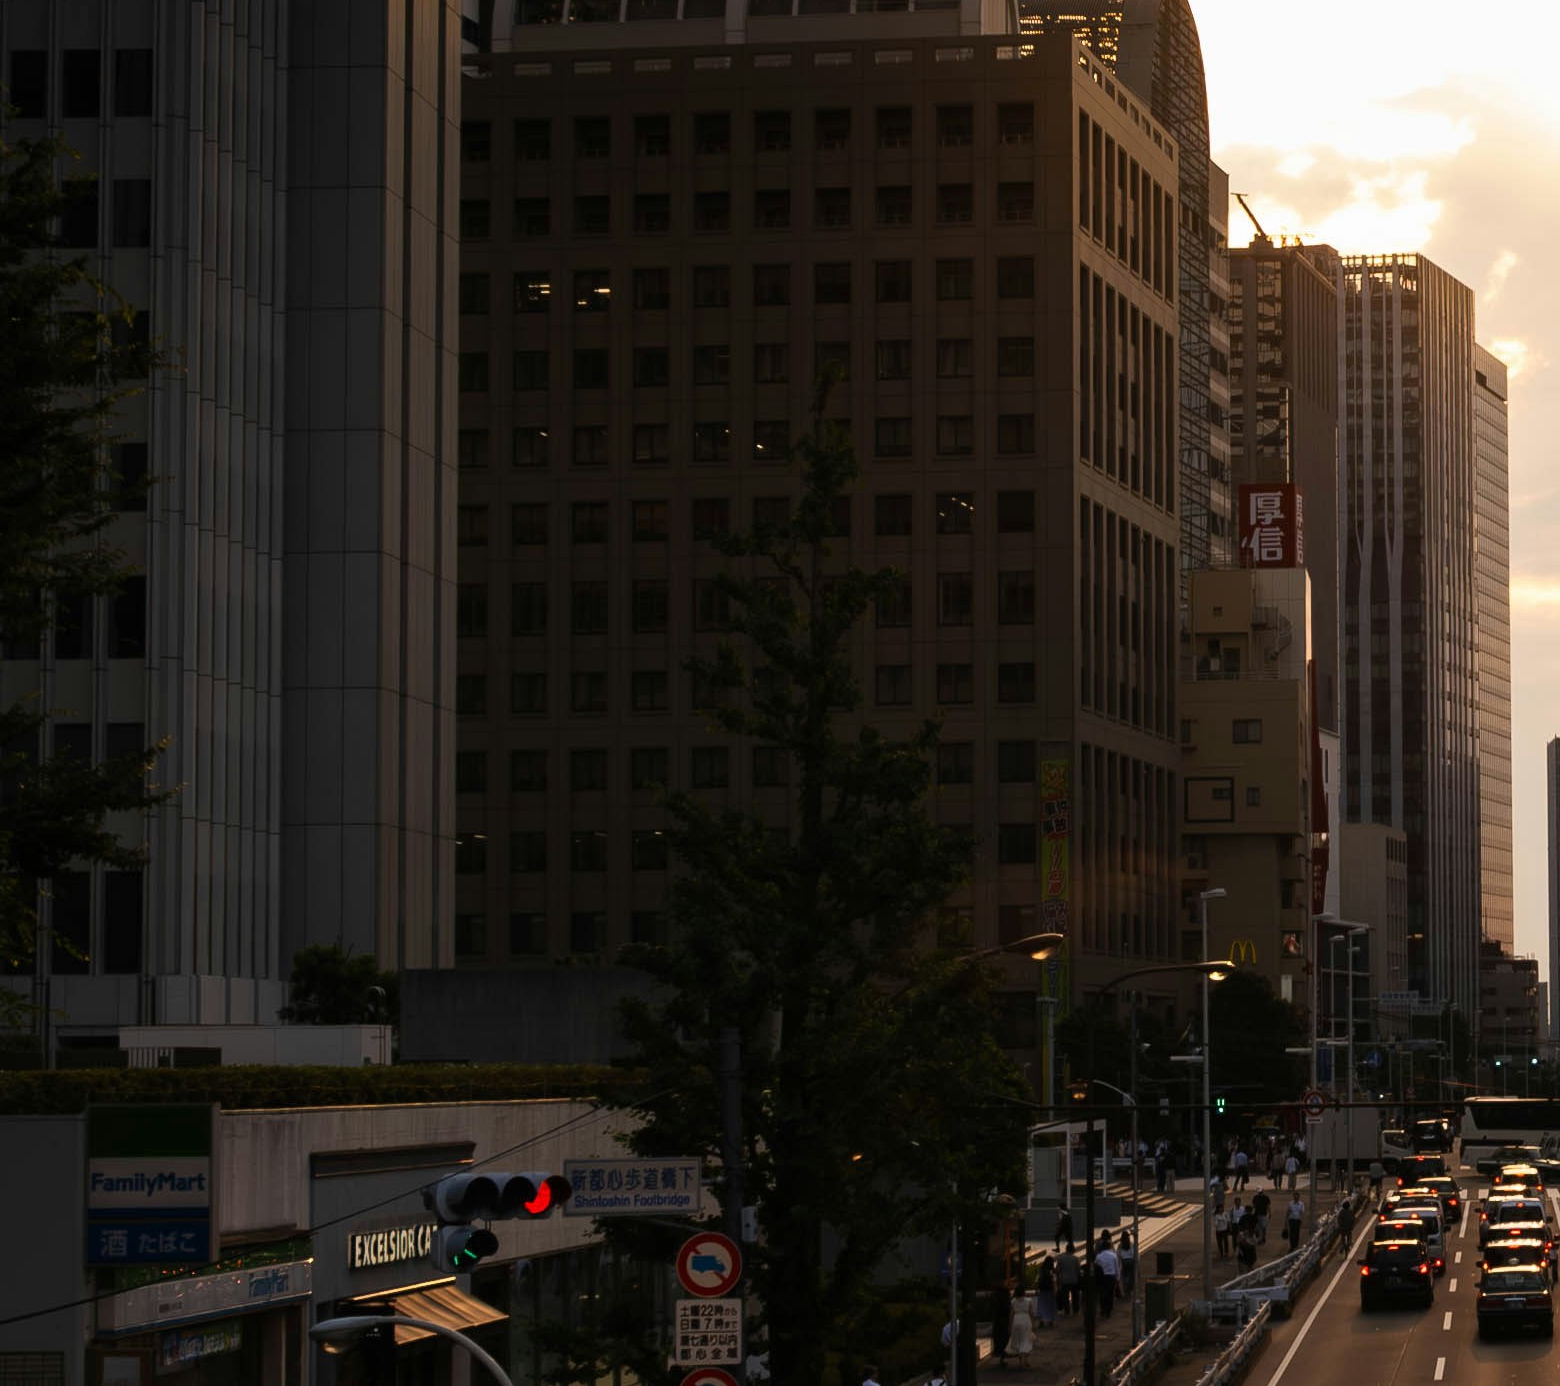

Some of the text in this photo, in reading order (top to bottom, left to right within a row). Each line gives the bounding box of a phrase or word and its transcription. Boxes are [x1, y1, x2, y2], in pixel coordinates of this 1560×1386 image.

[91, 1173, 207, 1197] FamilyMart
[572, 1167, 696, 1191] 新都心歩道橋下
[574, 1193, 690, 1208] Shintoshin Footbridge
[99, 1229, 198, 1258] 酒 たばこ
[354, 1223, 438, 1269] EXCELSIOR CA
